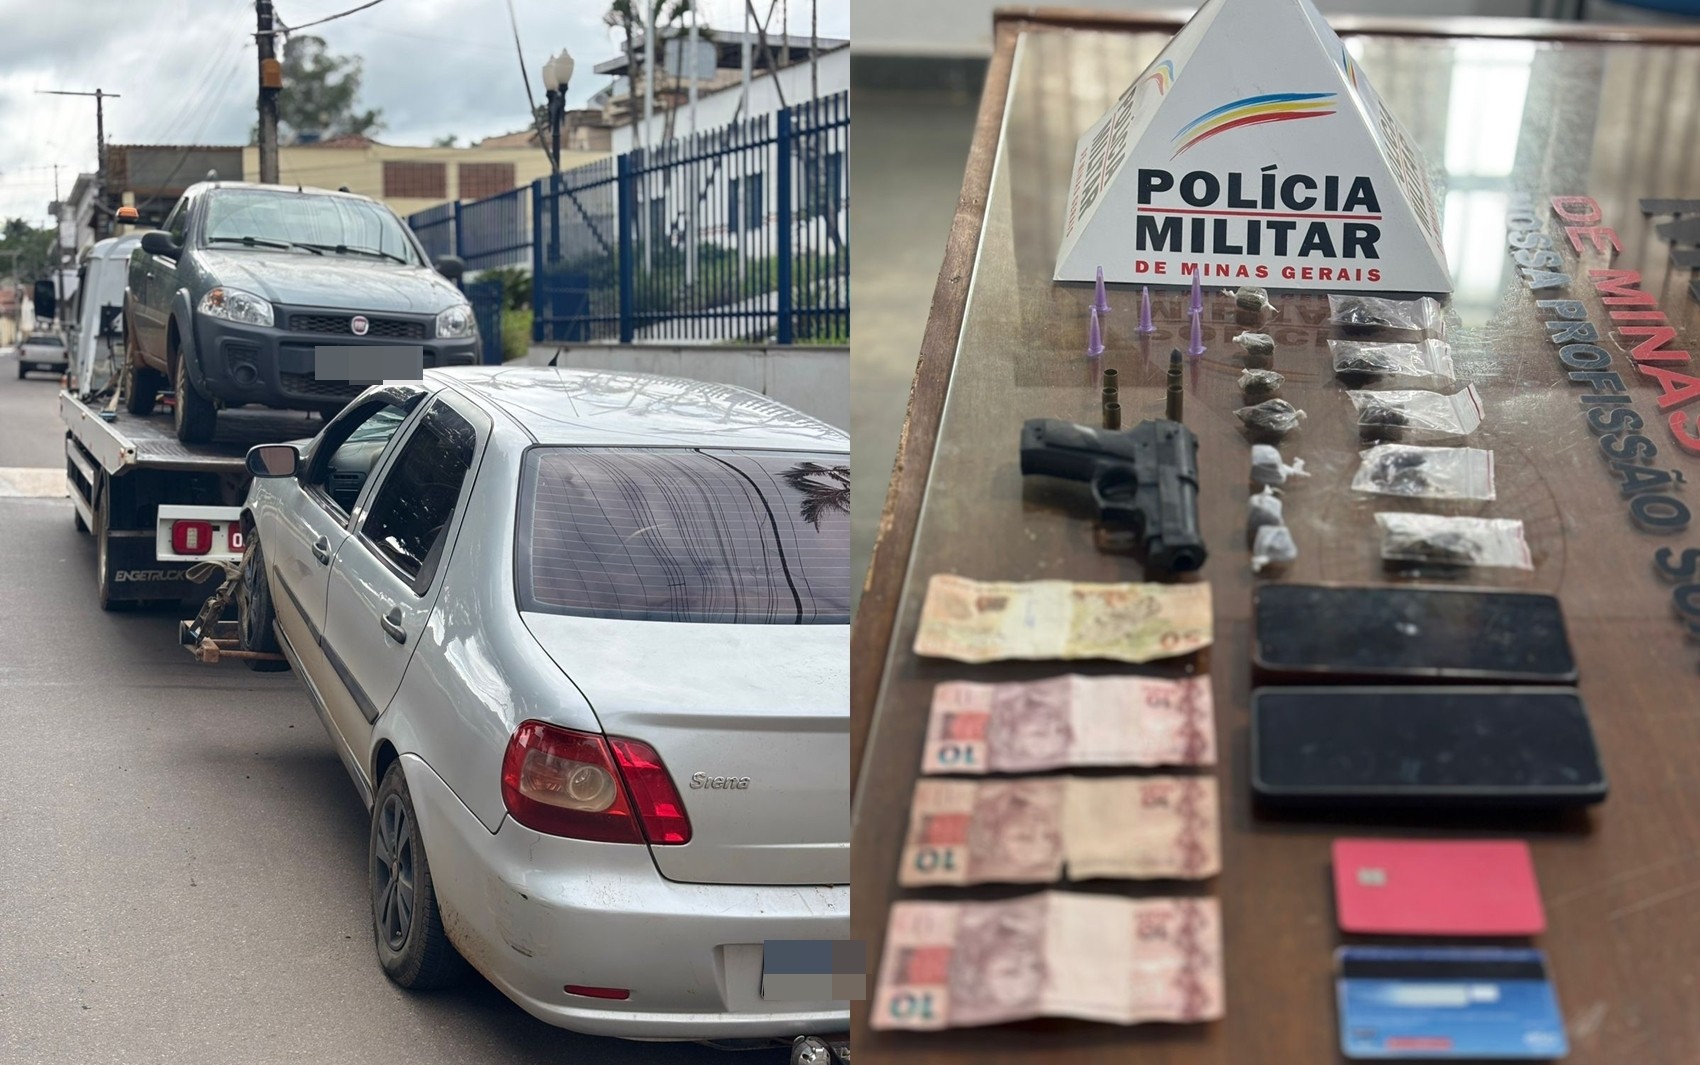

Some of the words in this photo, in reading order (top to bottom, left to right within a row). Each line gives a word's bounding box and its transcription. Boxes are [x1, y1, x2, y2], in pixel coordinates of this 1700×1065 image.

[1137, 164, 1381, 213] POLÍCIA
[1551, 196, 1624, 252] DE
[1135, 215, 1381, 260] MILITAR
[1135, 260, 1167, 275] DE
[1181, 262, 1268, 278] MINAS
[1281, 266, 1382, 283] GERAIS
[1536, 299, 1692, 527] PROFISSÃO
[115, 570, 185, 582] ENGETRUCK
[938, 745, 976, 764] 10
[689, 771, 751, 790] Siena
[914, 850, 956, 873] 10
[889, 993, 936, 1020] 10
